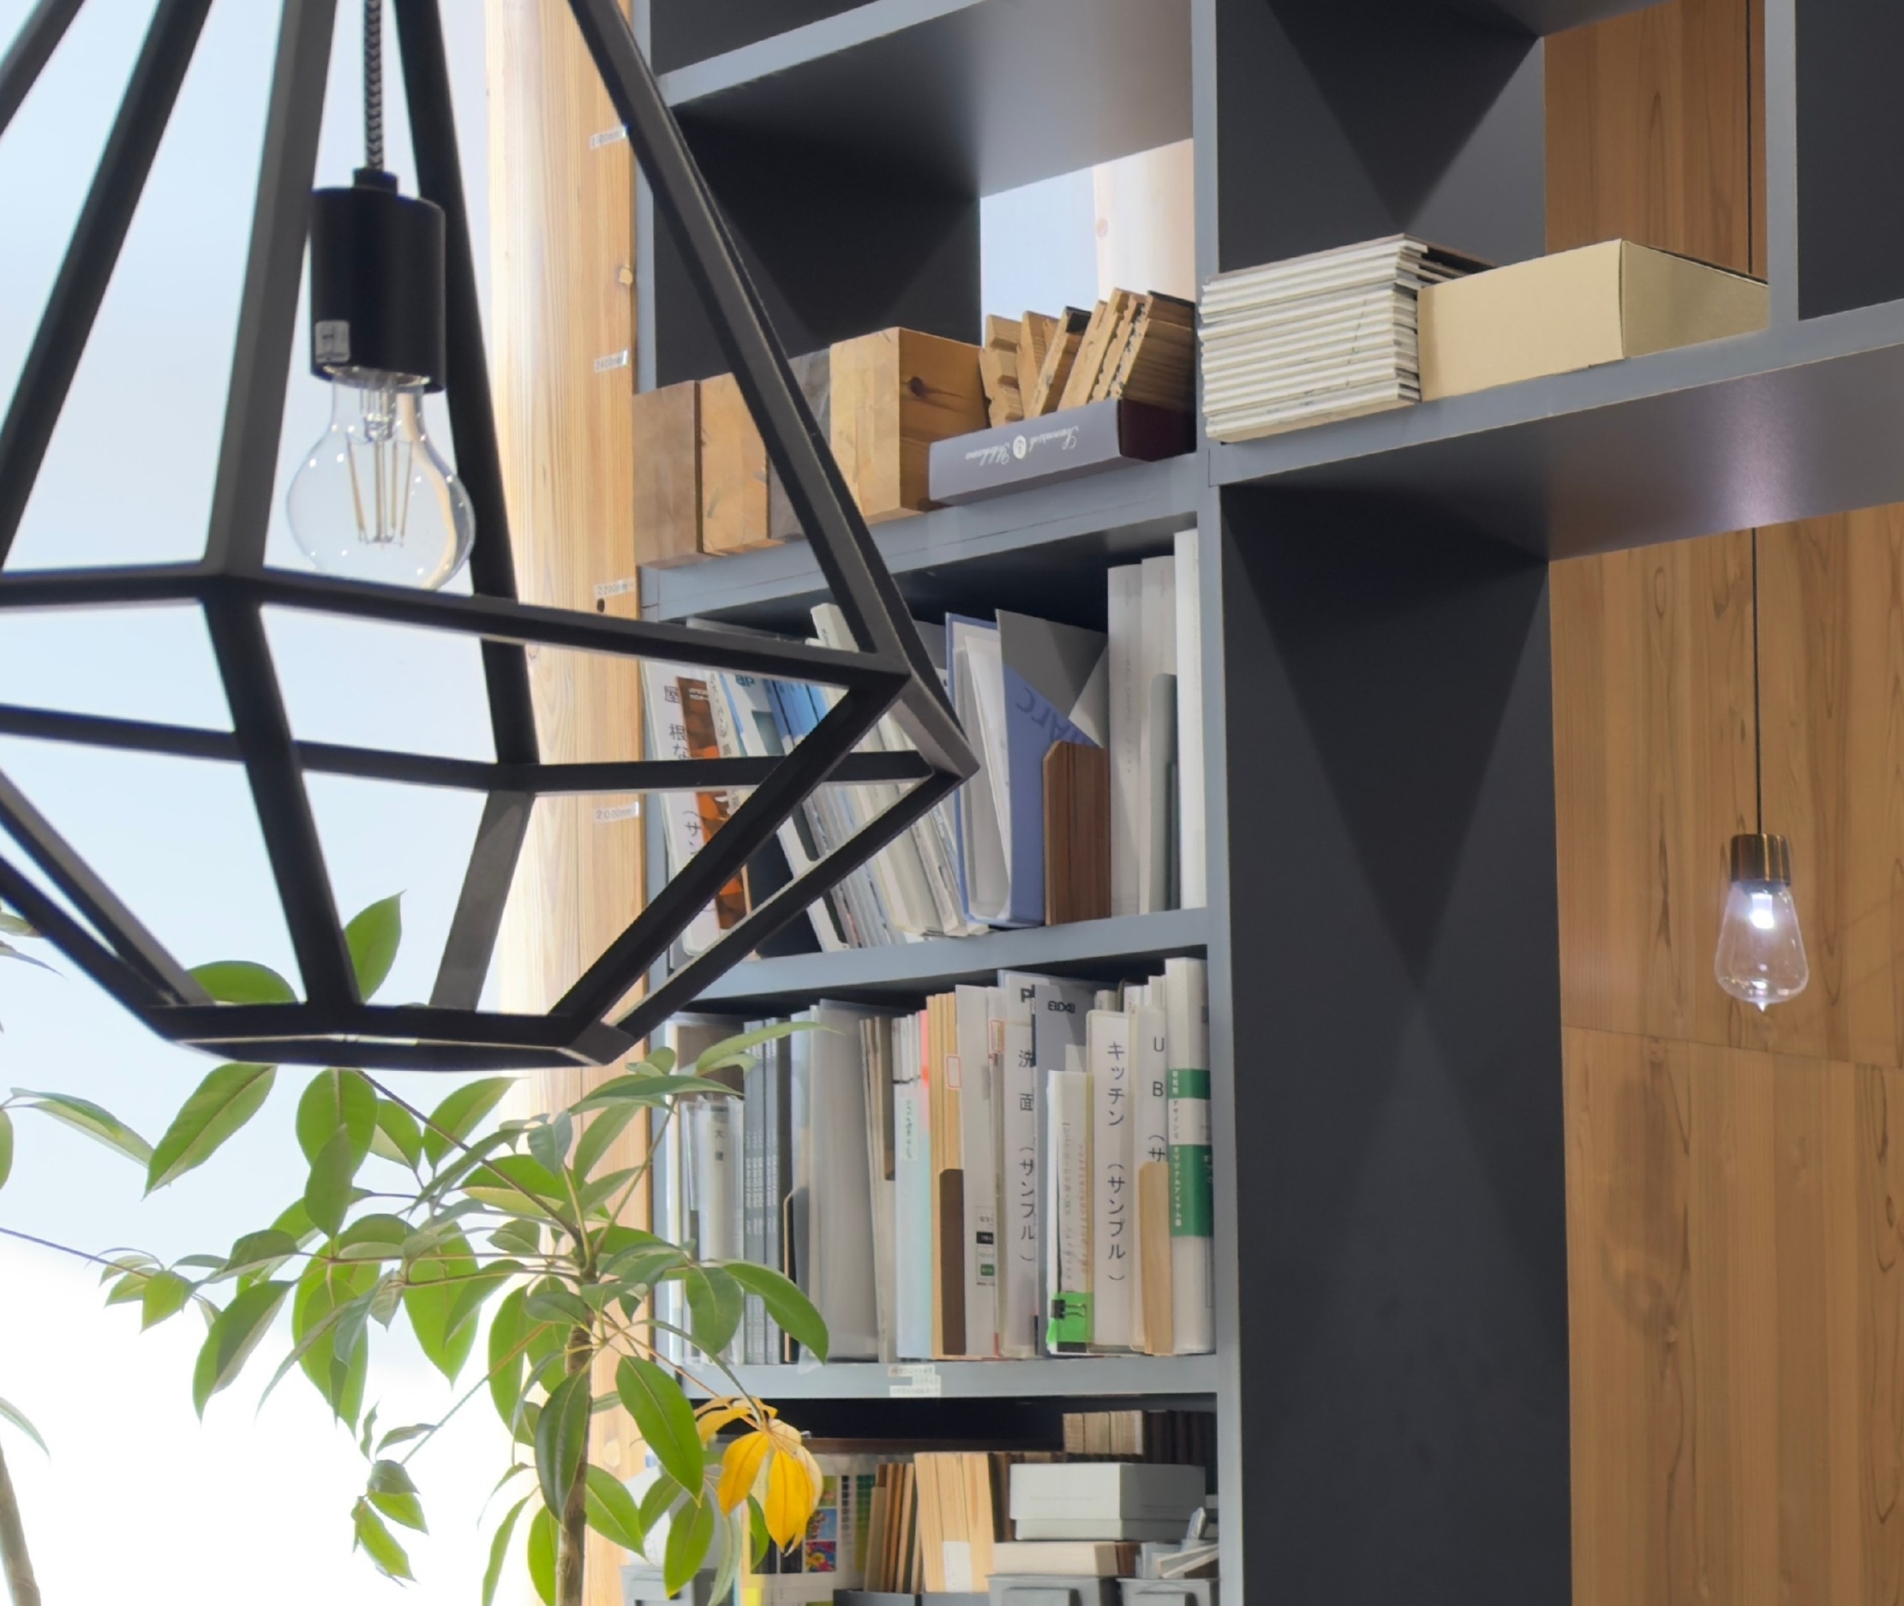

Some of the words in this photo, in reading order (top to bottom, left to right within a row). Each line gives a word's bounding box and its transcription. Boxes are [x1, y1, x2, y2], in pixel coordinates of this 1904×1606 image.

[1018, 1049, 1034, 1112] 洗面
[1107, 1042, 1125, 1126] キッチン
